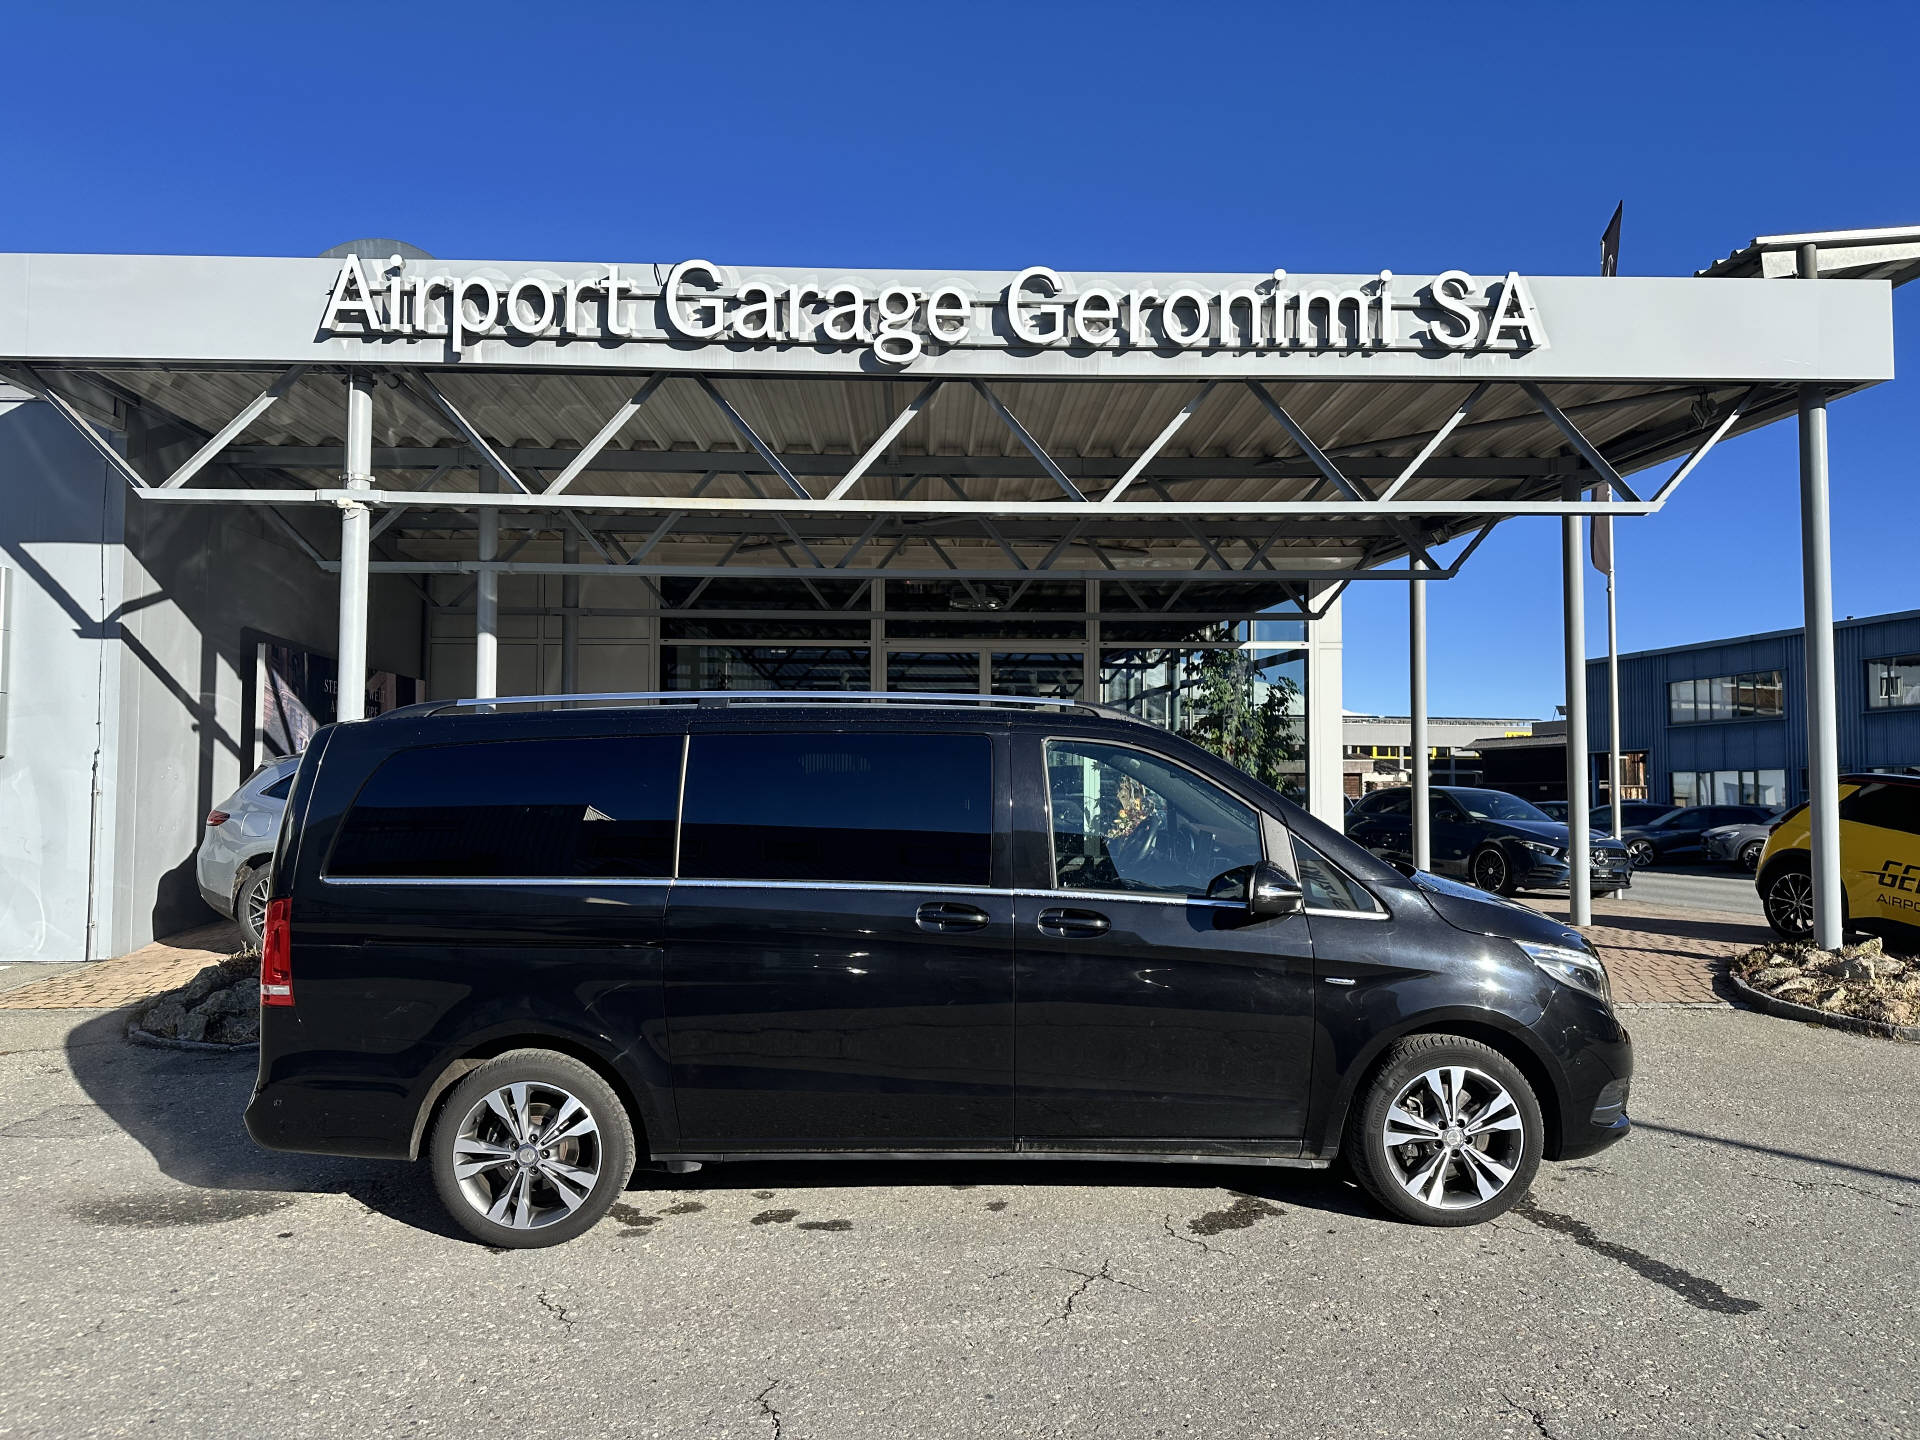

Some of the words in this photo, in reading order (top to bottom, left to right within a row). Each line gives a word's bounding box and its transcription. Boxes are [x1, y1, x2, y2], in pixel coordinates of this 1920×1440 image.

[321, 253, 632, 353] Airport
[665, 259, 969, 363] Garage
[1008, 266, 1394, 348] Geronimi
[1427, 270, 1543, 349] SA
